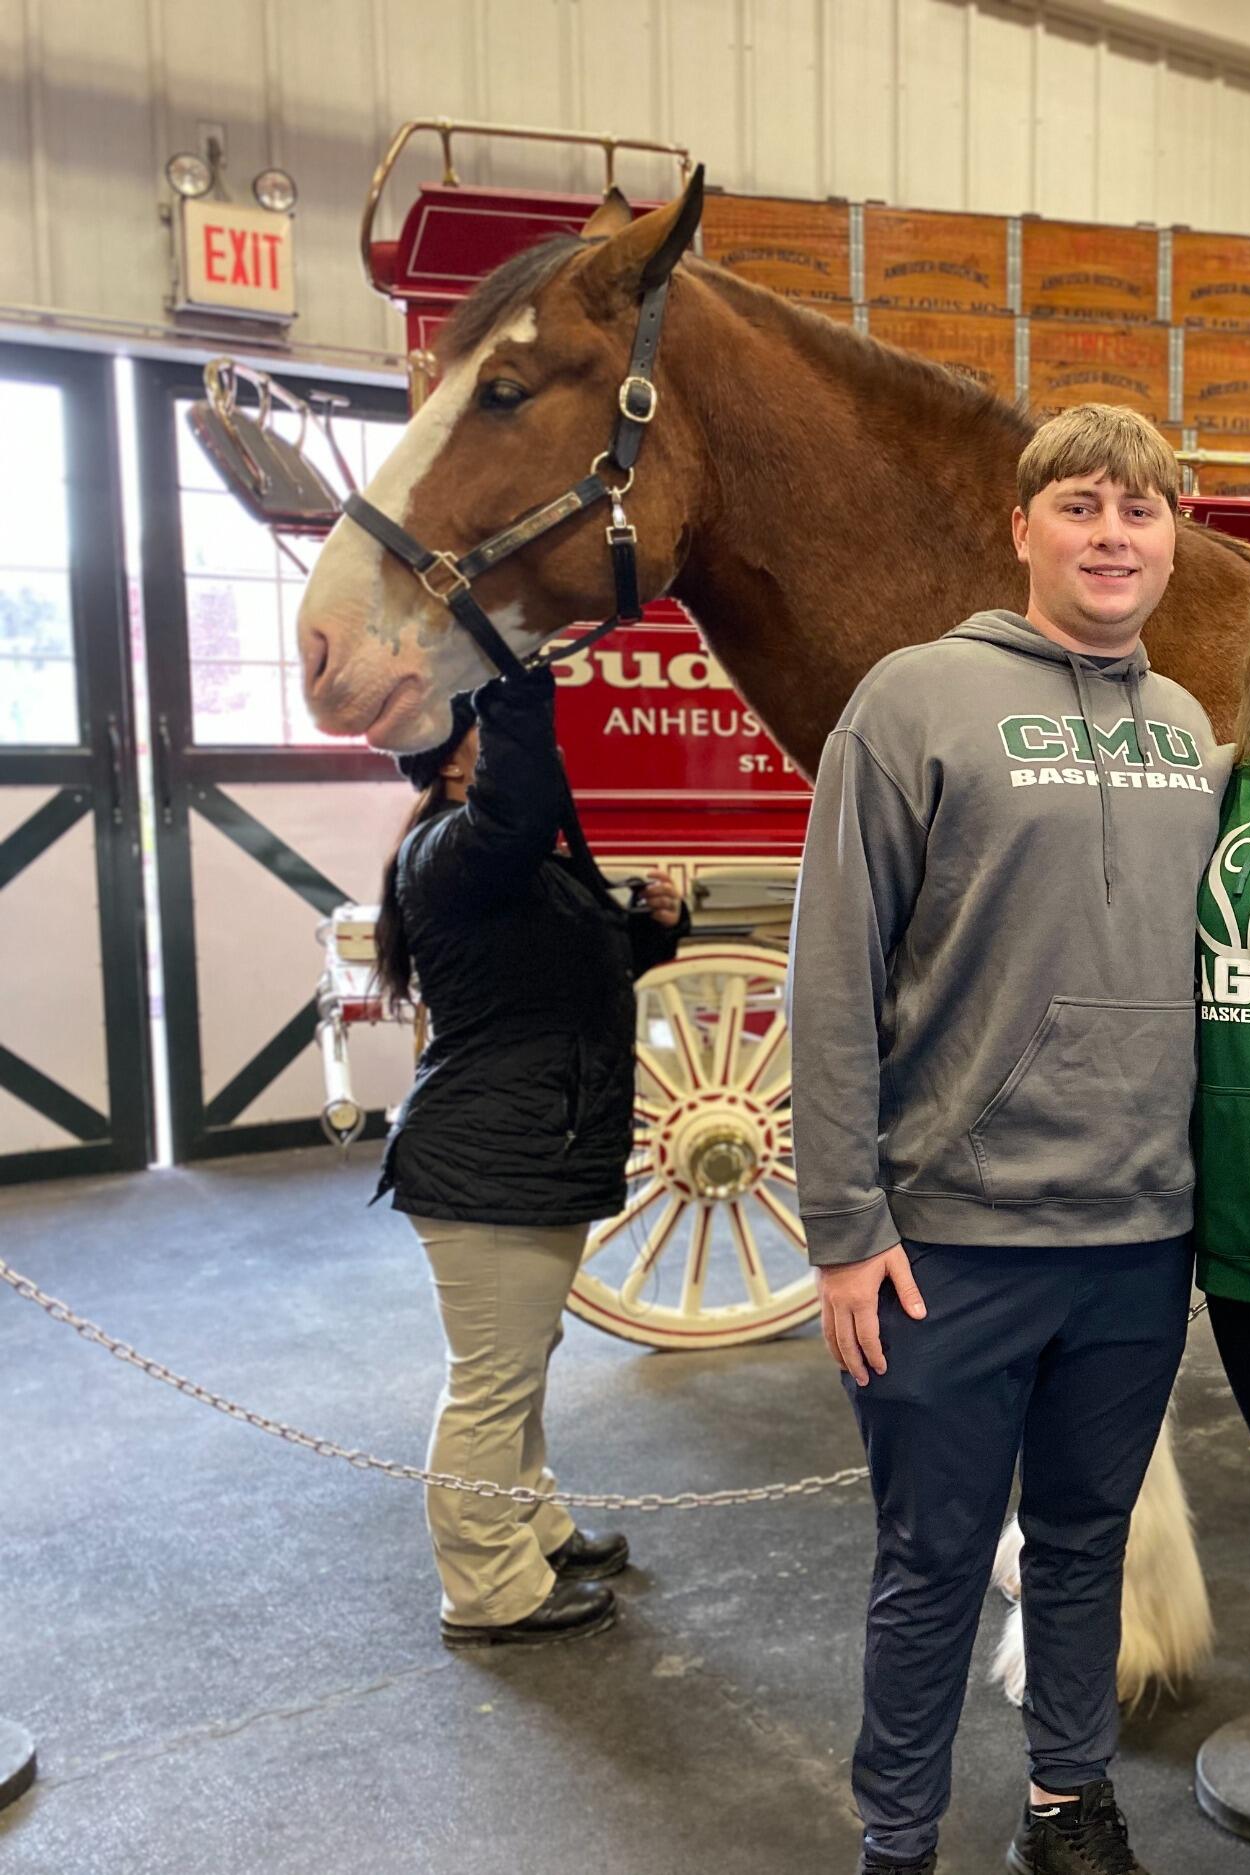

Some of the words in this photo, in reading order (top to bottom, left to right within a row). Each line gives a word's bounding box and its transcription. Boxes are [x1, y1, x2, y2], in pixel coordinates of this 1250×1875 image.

[204, 225, 283, 290] EXIT
[998, 714, 1203, 770] CMU
[739, 754, 774, 774] ST.
[1010, 767, 1214, 795] BASKETBALL
